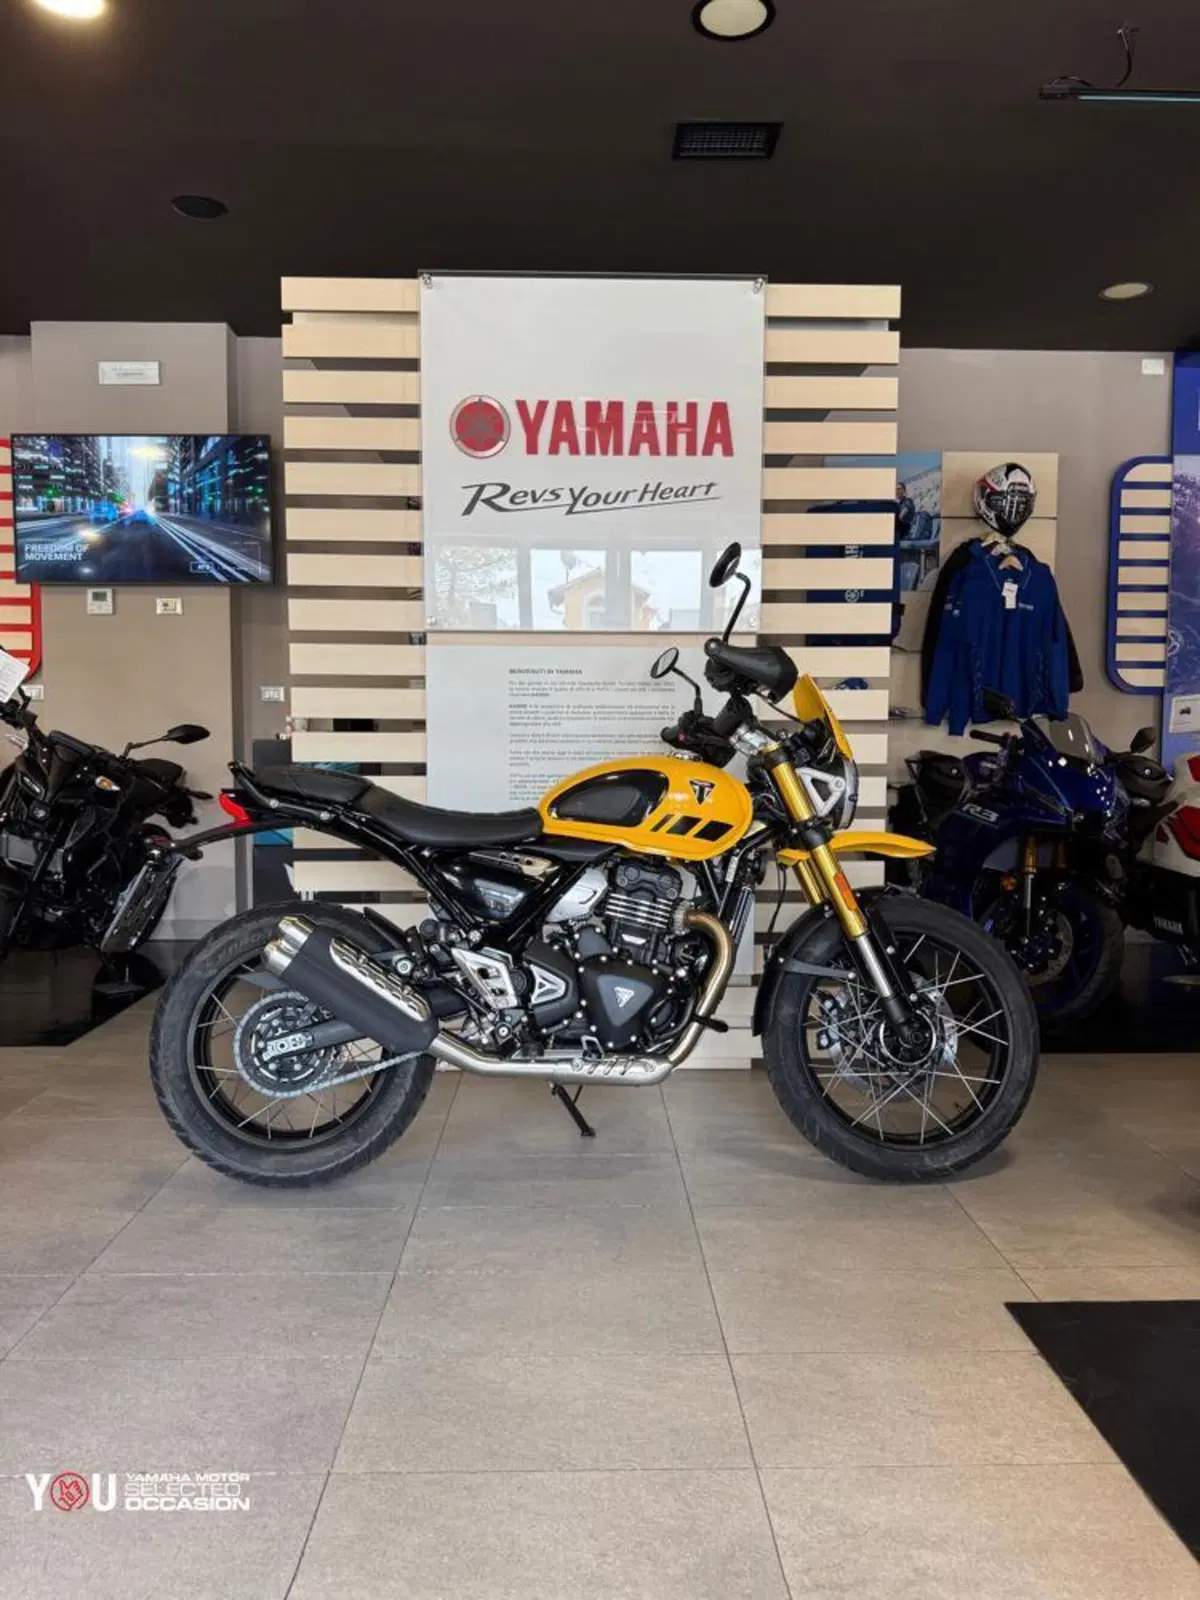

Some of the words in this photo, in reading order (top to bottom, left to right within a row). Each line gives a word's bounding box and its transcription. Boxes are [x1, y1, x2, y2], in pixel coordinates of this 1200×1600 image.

[515, 400, 735, 457] YAMAHA
[461, 482, 566, 516] Revs
[564, 485, 638, 516] Your
[638, 481, 720, 503] Heart
[24, 553, 83, 561] MOVEMENT
[962, 803, 999, 821] R3
